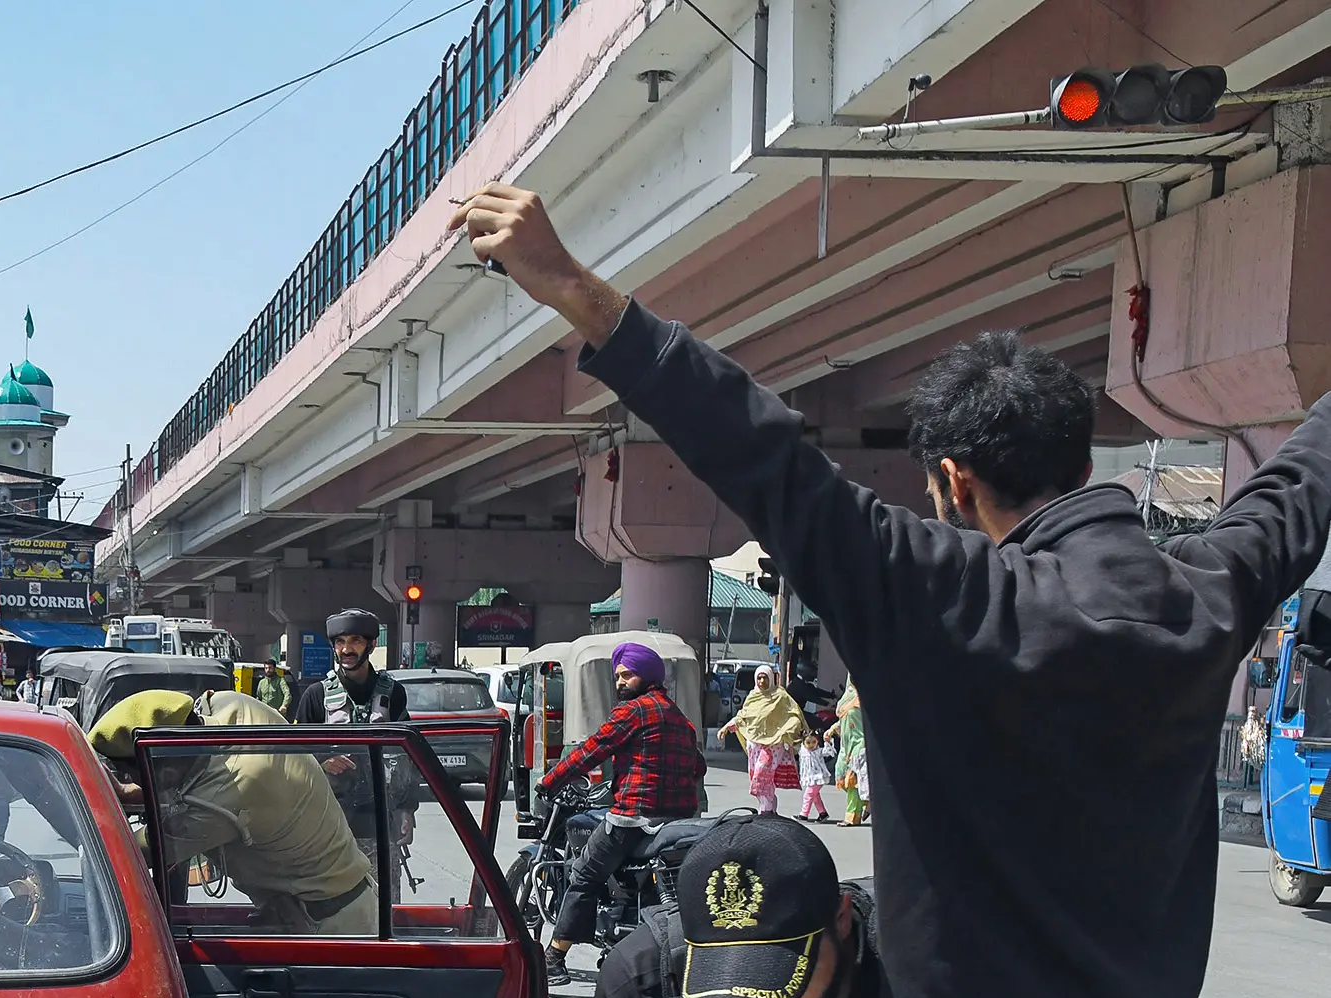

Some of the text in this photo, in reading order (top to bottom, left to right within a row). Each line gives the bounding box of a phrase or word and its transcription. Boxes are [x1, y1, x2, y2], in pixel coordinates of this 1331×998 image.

[33, 540, 67, 549] CORNER
[0, 594, 85, 609] OOD CORNER
[719, 910, 748, 919] POLICE
[785, 954, 809, 997] FORCES
